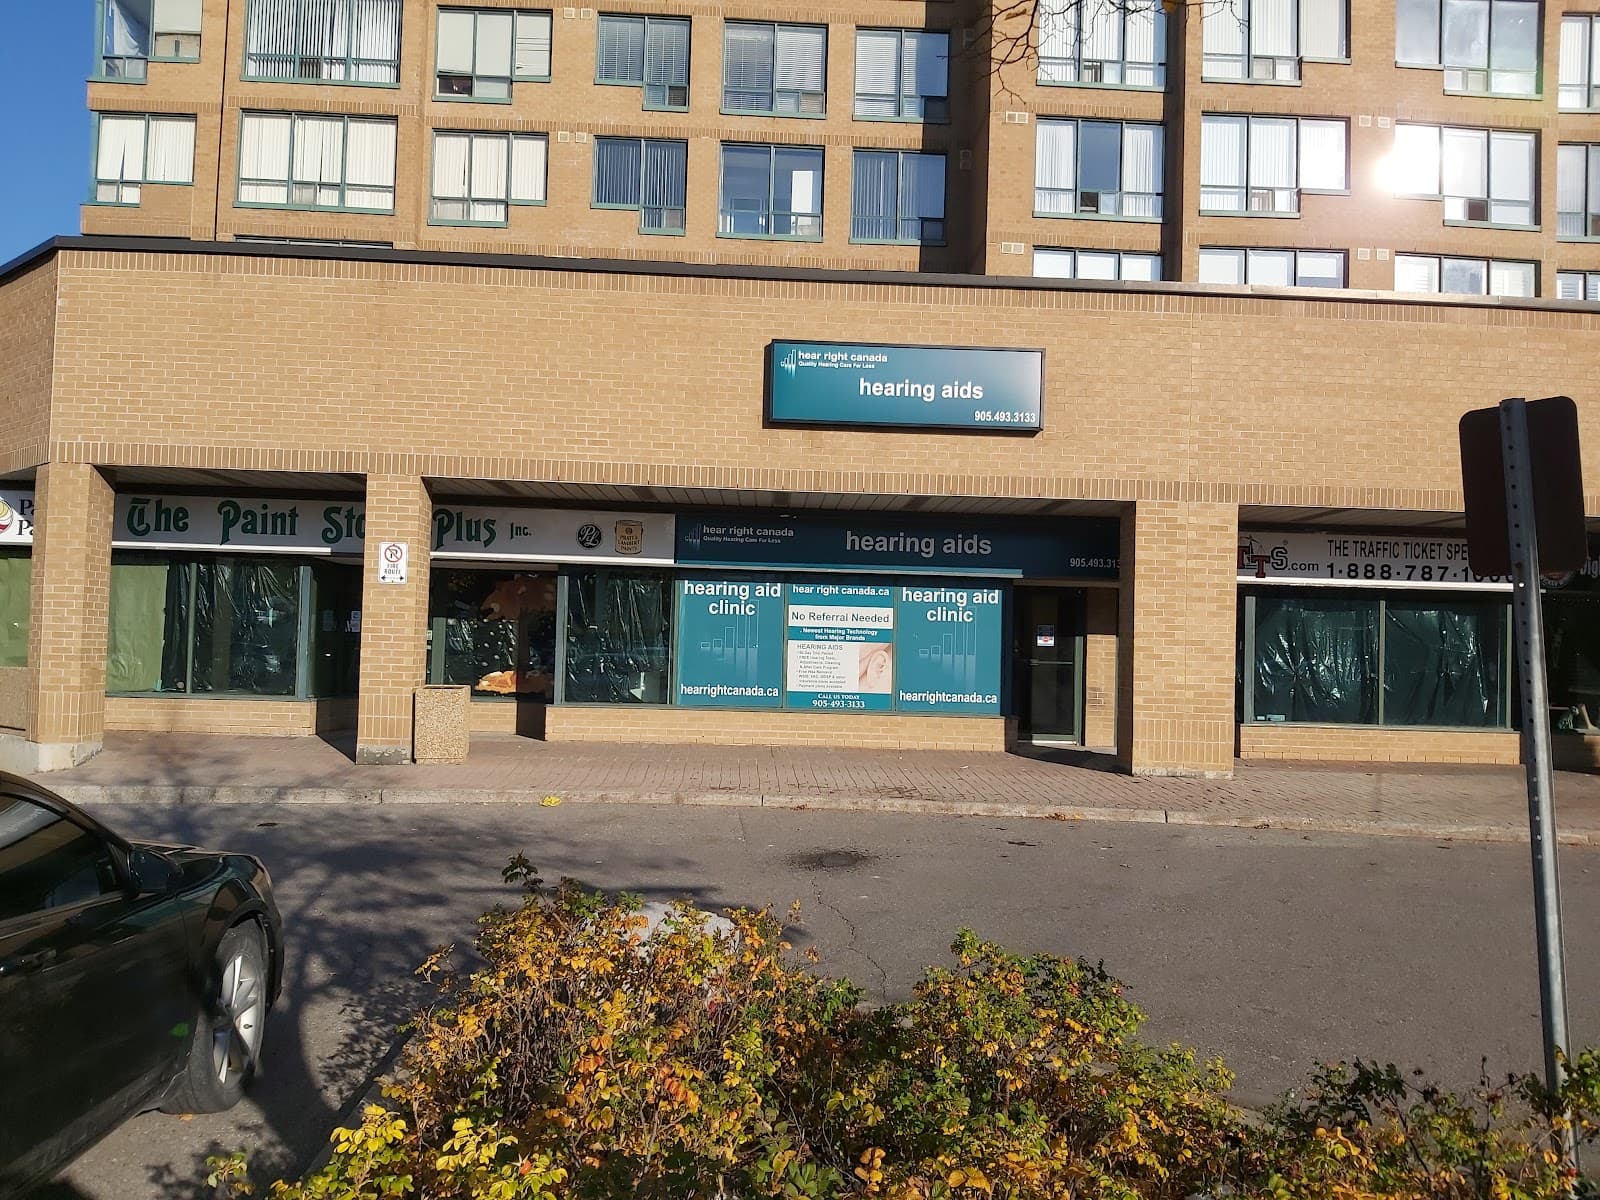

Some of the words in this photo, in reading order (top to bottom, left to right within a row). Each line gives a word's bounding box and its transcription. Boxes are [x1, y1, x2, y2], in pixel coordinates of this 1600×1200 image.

[798, 350, 822, 360] hear
[824, 351, 848, 362] right
[850, 353, 888, 362] canada
[859, 377, 935, 402] hearing
[941, 380, 984, 399] aids
[974, 410, 1036, 423] 905.493.3133
[126, 497, 190, 536] The
[217, 499, 299, 546] Paint
[321, 506, 365, 544] Sto
[432, 508, 497, 551] Plus
[510, 522, 532, 540] Inc.
[703, 525, 727, 534] hear
[729, 526, 754, 537] right
[756, 526, 794, 537] canada
[846, 530, 934, 558] hearing
[942, 533, 992, 555] aids
[1327, 539, 1349, 557] THE
[1352, 540, 1400, 558] TRAFFIC
[1403, 542, 1443, 560] TICKET
[1446, 543, 1468, 560] SPE
[1070, 557, 1120, 568] 905.493.313
[684, 580, 750, 600] hearing
[755, 582, 781, 597] aid
[792, 584, 814, 594] hear
[816, 585, 839, 596] right
[841, 586, 890, 596] canada.ca
[902, 587, 968, 607] hearing
[973, 589, 999, 604] aid
[708, 600, 756, 616] clinic
[927, 607, 974, 622] clinic
[791, 612, 806, 621] No
[809, 612, 849, 622] Referral
[851, 613, 890, 623] Needed
[680, 683, 779, 698] hearrightcanada.ca
[899, 690, 998, 705] hearrightcanada.ca
[812, 700, 865, 708] 905-493-3133
